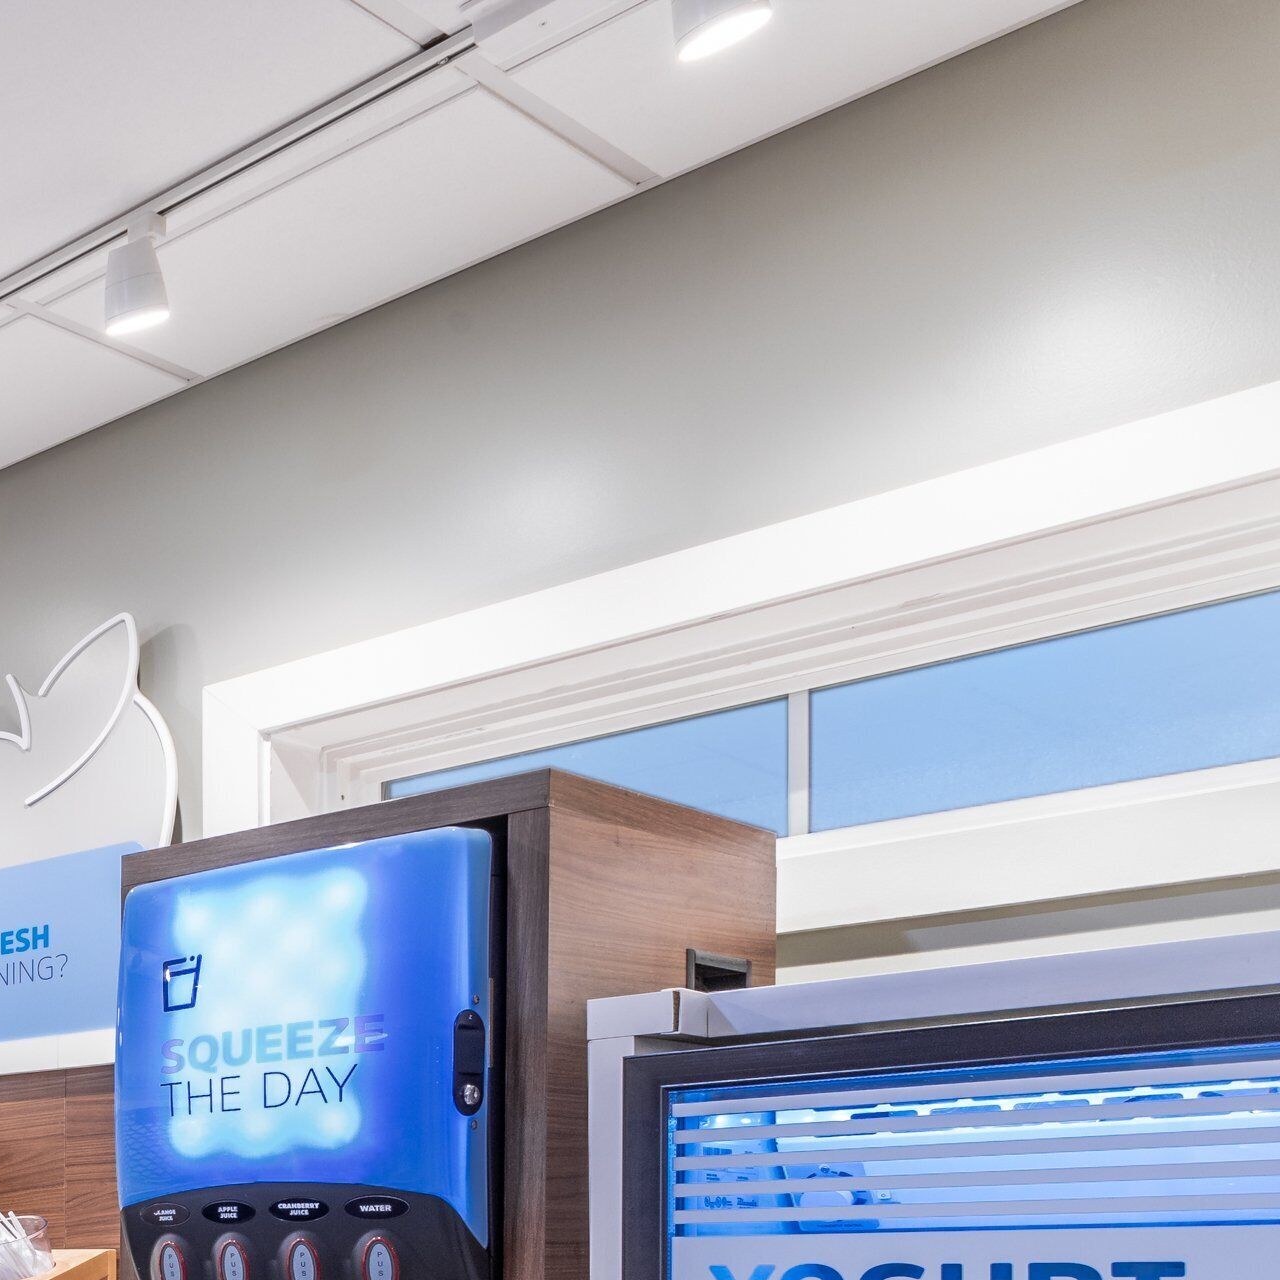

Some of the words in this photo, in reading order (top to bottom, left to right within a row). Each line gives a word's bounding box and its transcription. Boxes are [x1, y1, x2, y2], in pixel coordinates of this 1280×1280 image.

[160, 1013, 389, 1074] SQUEEZE
[160, 1075, 242, 1117] THE
[263, 1063, 358, 1109] DAY
[359, 1204, 392, 1212] WATER
